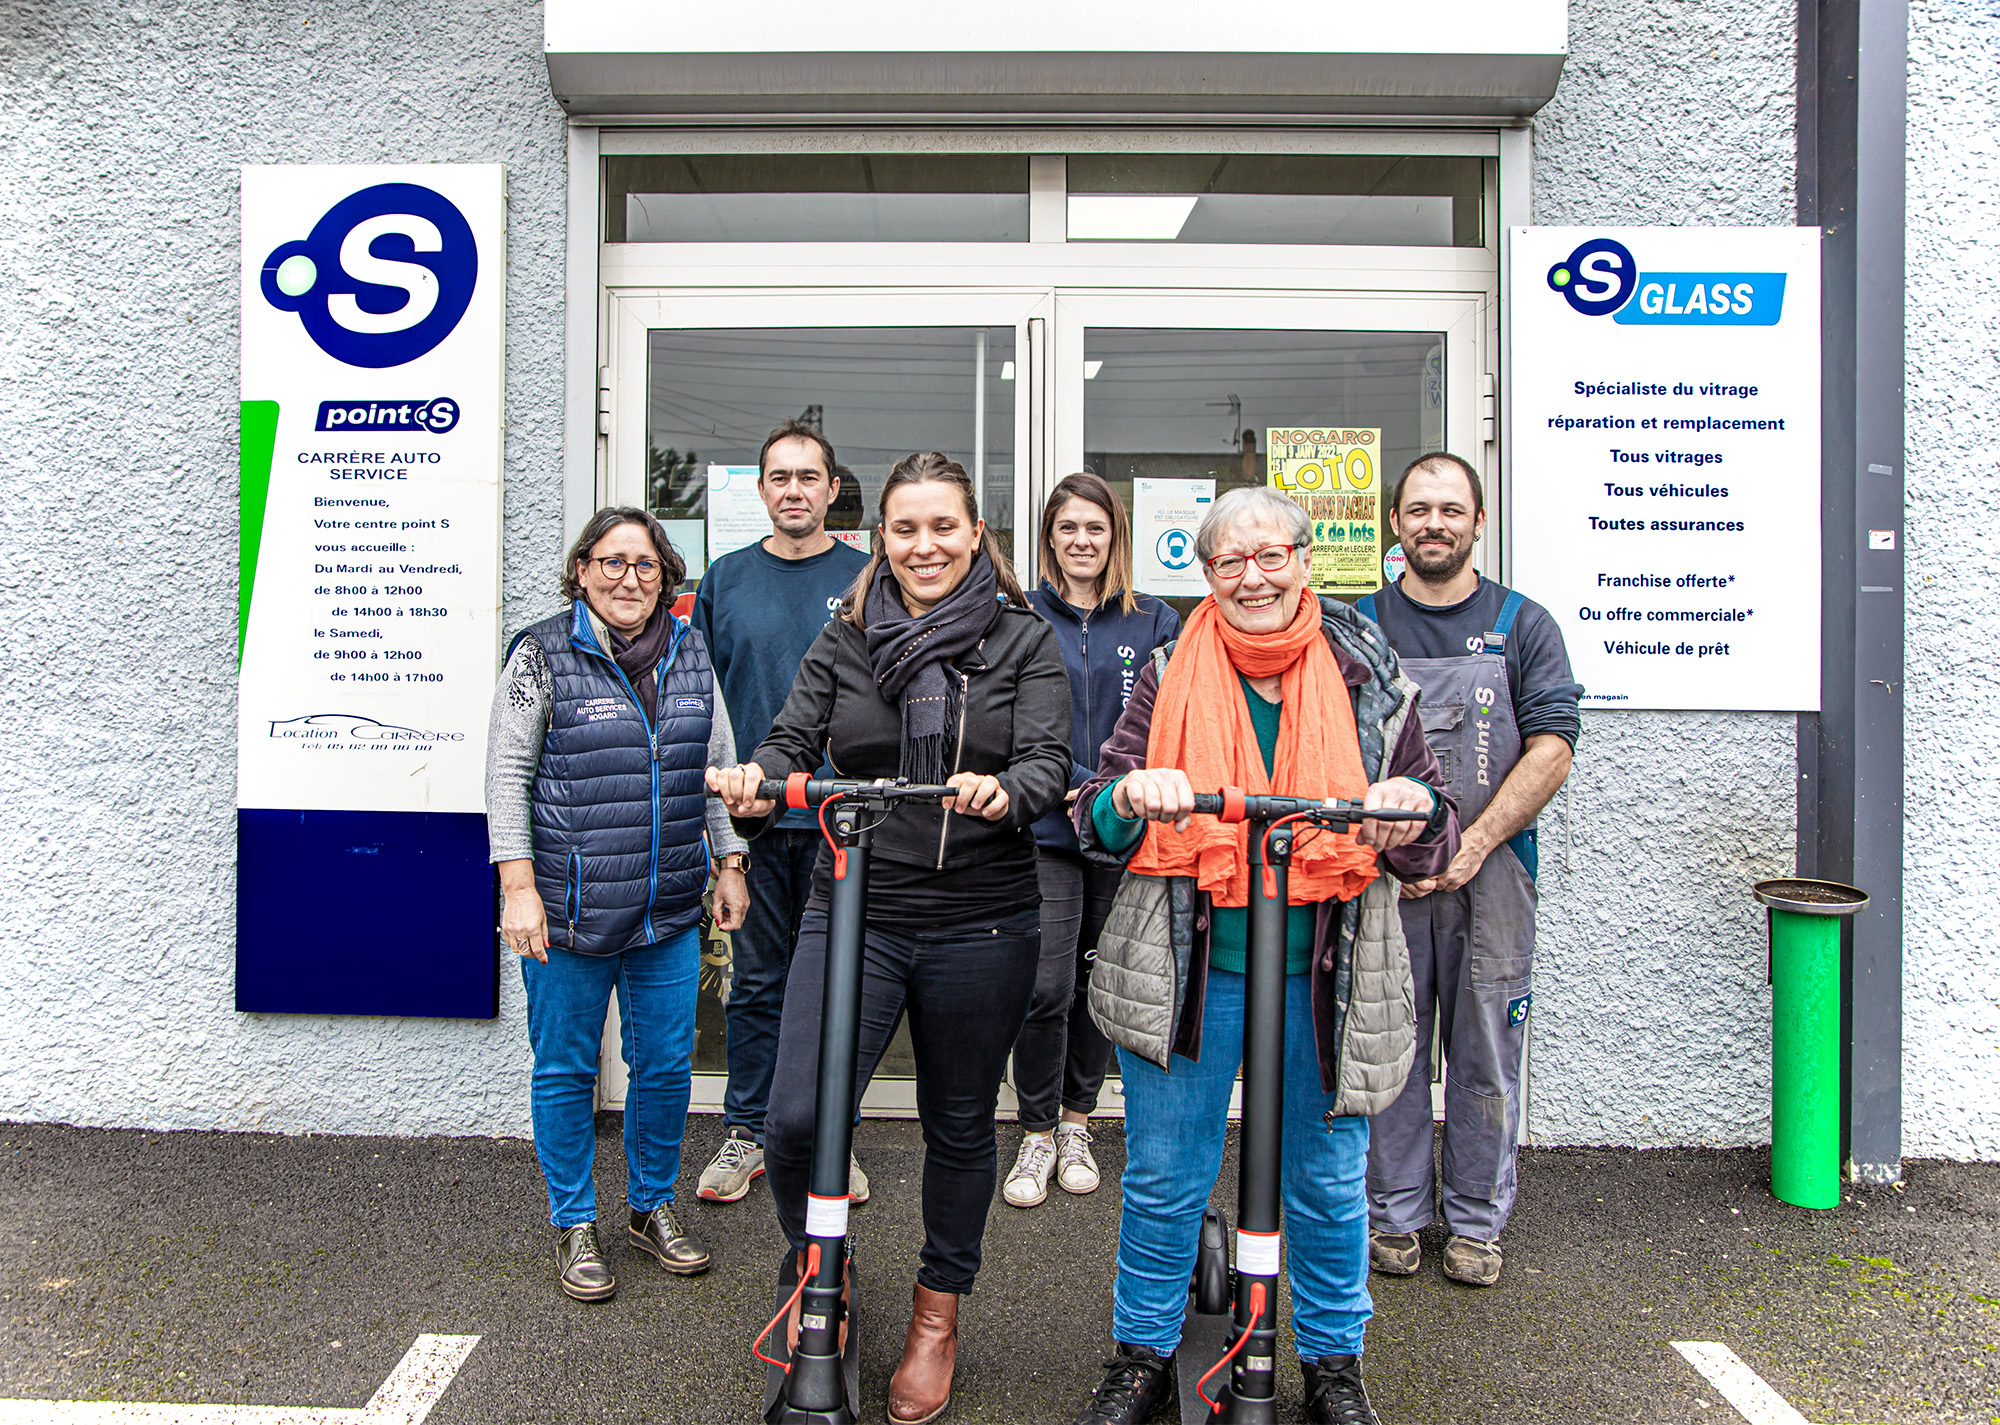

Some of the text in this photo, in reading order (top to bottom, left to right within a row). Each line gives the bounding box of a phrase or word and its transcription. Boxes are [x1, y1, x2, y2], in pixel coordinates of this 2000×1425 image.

[328, 213, 443, 334] S
[1574, 251, 1754, 315] S GLASS
[1574, 380, 1759, 399] Spécialiste du vitrage
[325, 402, 454, 428] point S
[1547, 414, 1786, 433] réparation et remplacement
[1271, 430, 1375, 445] NOGARO
[297, 449, 441, 464] CARRÈRE AUTO
[1609, 448, 1723, 467] Tous vitrages
[329, 468, 408, 480] SERVICE
[1273, 447, 1373, 490] LOTO
[1603, 482, 1729, 498] Tous véhicules
[314, 496, 390, 508] Bienvenue,
[1311, 495, 1336, 520] BONS
[1336, 495, 1376, 520] D'ACHAT
[313, 518, 450, 531] Votre centre point S
[1328, 521, 1345, 542] de
[1349, 522, 1375, 542] lots
[1588, 516, 1745, 532] Toutes assurances
[314, 544, 347, 552] vous
[350, 542, 407, 552] accueille
[1312, 545, 1344, 553] ARREFOUR
[1350, 545, 1376, 553] LECLERC
[314, 563, 463, 575] Du Mardi au Vendredi,
[1597, 573, 1672, 588] Franchise
[314, 585, 423, 596] de 8h00 à 12h00
[331, 606, 448, 617] de 14h00 à 18h30
[1578, 606, 1601, 621] Ou
[1606, 606, 1643, 622] offre
[314, 628, 383, 640] le Samedi,
[313, 649, 423, 660] de 9h00 à 12h00
[1603, 640, 1730, 659] Véhicule de prêt
[330, 672, 444, 683] de 14h00 à 17h00
[1593, 693, 1629, 702] magasin
[576, 703, 627, 715] AUTO SERVICES
[588, 712, 618, 722] NOGARO
[269, 721, 338, 739] Location
[1475, 687, 1495, 786] S point
[1517, 1000, 1528, 1021] S
